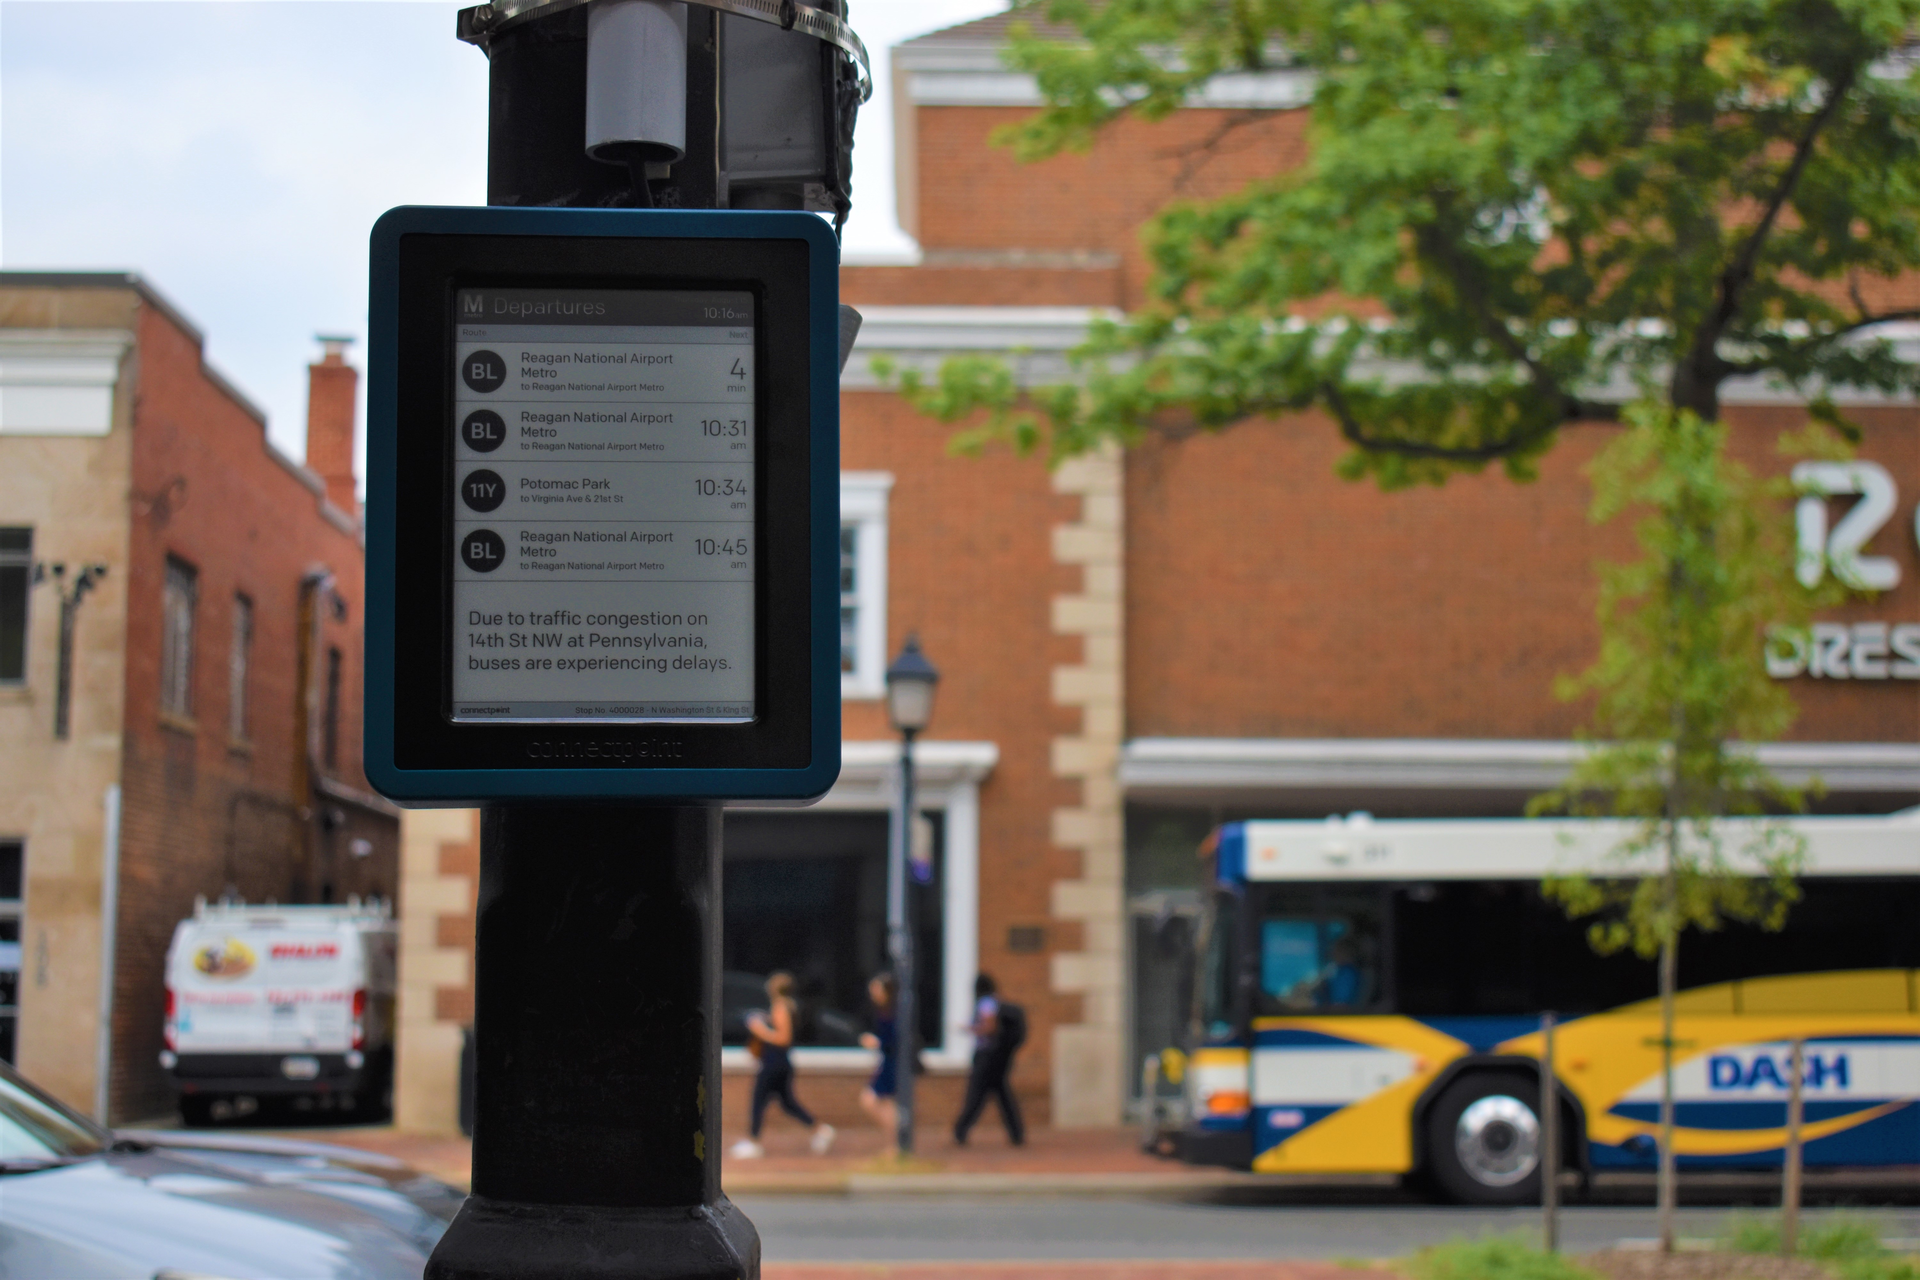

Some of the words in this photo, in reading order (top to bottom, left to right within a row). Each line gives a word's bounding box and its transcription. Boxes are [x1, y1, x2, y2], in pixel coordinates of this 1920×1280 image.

[464, 295, 483, 313] M
[494, 298, 605, 318] Departures
[463, 328, 486, 336] Route
[729, 331, 748, 339] Next
[521, 352, 570, 365] Reagan
[574, 352, 627, 364] National
[630, 353, 673, 366] Airport
[471, 363, 497, 379] BL
[521, 367, 557, 378] Metro
[730, 358, 746, 380] 4
[521, 383, 530, 391] to
[532, 383, 566, 393] Reagan
[568, 383, 605, 392] National
[608, 383, 637, 393] Airport
[640, 383, 664, 392] Metro
[727, 383, 746, 393] min
[521, 412, 570, 424] Reagan
[574, 412, 627, 423] National
[630, 412, 673, 425] Airport
[471, 423, 497, 439] BL
[521, 427, 557, 437] Metro
[701, 420, 747, 436] 10:31
[521, 442, 530, 450] to
[532, 442, 566, 452] Reagan
[568, 442, 605, 451] National
[608, 442, 637, 452] Airport
[640, 443, 664, 451] Metro
[730, 442, 746, 450] am
[470, 483, 496, 498] 11Y
[521, 478, 579, 490] Potomac
[583, 478, 610, 490] Park
[695, 479, 747, 496] 10:34
[521, 495, 530, 503] to
[532, 494, 564, 504] Virginia
[566, 495, 584, 503] Ave
[585, 495, 592, 503] &
[594, 495, 611, 503] 21st
[613, 495, 623, 503] St
[730, 501, 746, 509] am
[1790, 458, 1920, 592] R
[521, 531, 570, 544] Reagan
[574, 531, 627, 543] National
[630, 532, 673, 545] Airport
[471, 542, 497, 558] BL
[521, 546, 557, 557] Metro
[695, 539, 747, 556] 10:45
[521, 562, 530, 570] to
[532, 562, 566, 572] Reagan
[568, 562, 605, 570] National
[608, 562, 637, 572] Airport
[640, 562, 664, 570] Metro
[730, 561, 747, 569] am
[469, 611, 503, 625] Due
[508, 613, 525, 625] to
[529, 610, 582, 625] traffic
[586, 611, 682, 629] congestion
[687, 614, 708, 625] on
[468, 633, 503, 647] 14th
[510, 633, 528, 647] St
[532, 633, 562, 647] NW
[568, 635, 584, 647] at
[590, 633, 708, 650] Pennsylvania,
[469, 655, 520, 669] buses
[525, 659, 552, 669] are
[557, 656, 667, 673] experiencing
[672, 656, 732, 673] delays.
[460, 706, 510, 714] connectpoint
[575, 706, 593, 714] Stop
[609, 706, 644, 714] 4000028
[651, 706, 657, 714] N
[658, 706, 704, 715] Washington
[706, 706, 714, 714] St
[716, 706, 722, 714] &
[723, 706, 740, 715] King
[527, 738, 682, 762] connectpoint
